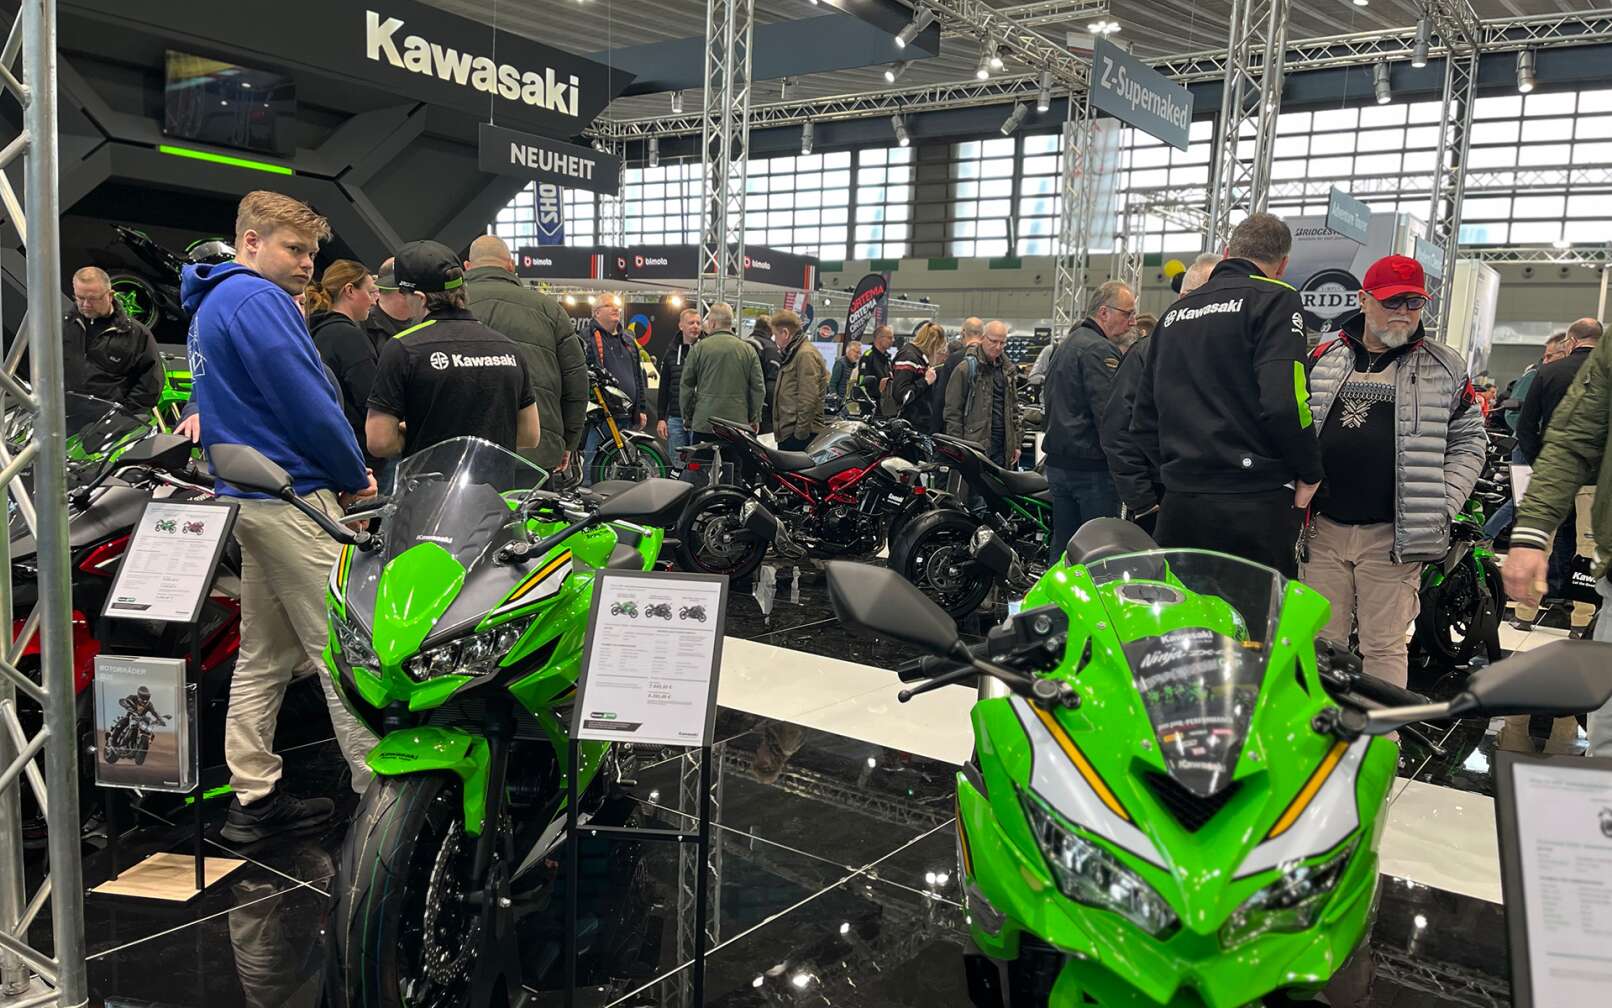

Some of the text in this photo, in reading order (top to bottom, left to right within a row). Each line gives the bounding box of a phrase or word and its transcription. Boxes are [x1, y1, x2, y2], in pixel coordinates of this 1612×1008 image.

[366, 9, 580, 117] Kawasaki
[1100, 56, 1189, 130] Z-Supernaked
[510, 142, 596, 180] NEUHEIT
[539, 183, 559, 223] SHO
[532, 258, 553, 266] bimota
[645, 257, 668, 266] bimota
[849, 298, 877, 323] ORTEMA
[1175, 298, 1243, 321] Kawasaki
[1303, 293, 1357, 307] RIDE
[451, 353, 517, 367] Kawasaki
[1572, 571, 1596, 583] Kaw
[1140, 647, 1186, 668] Ninja
